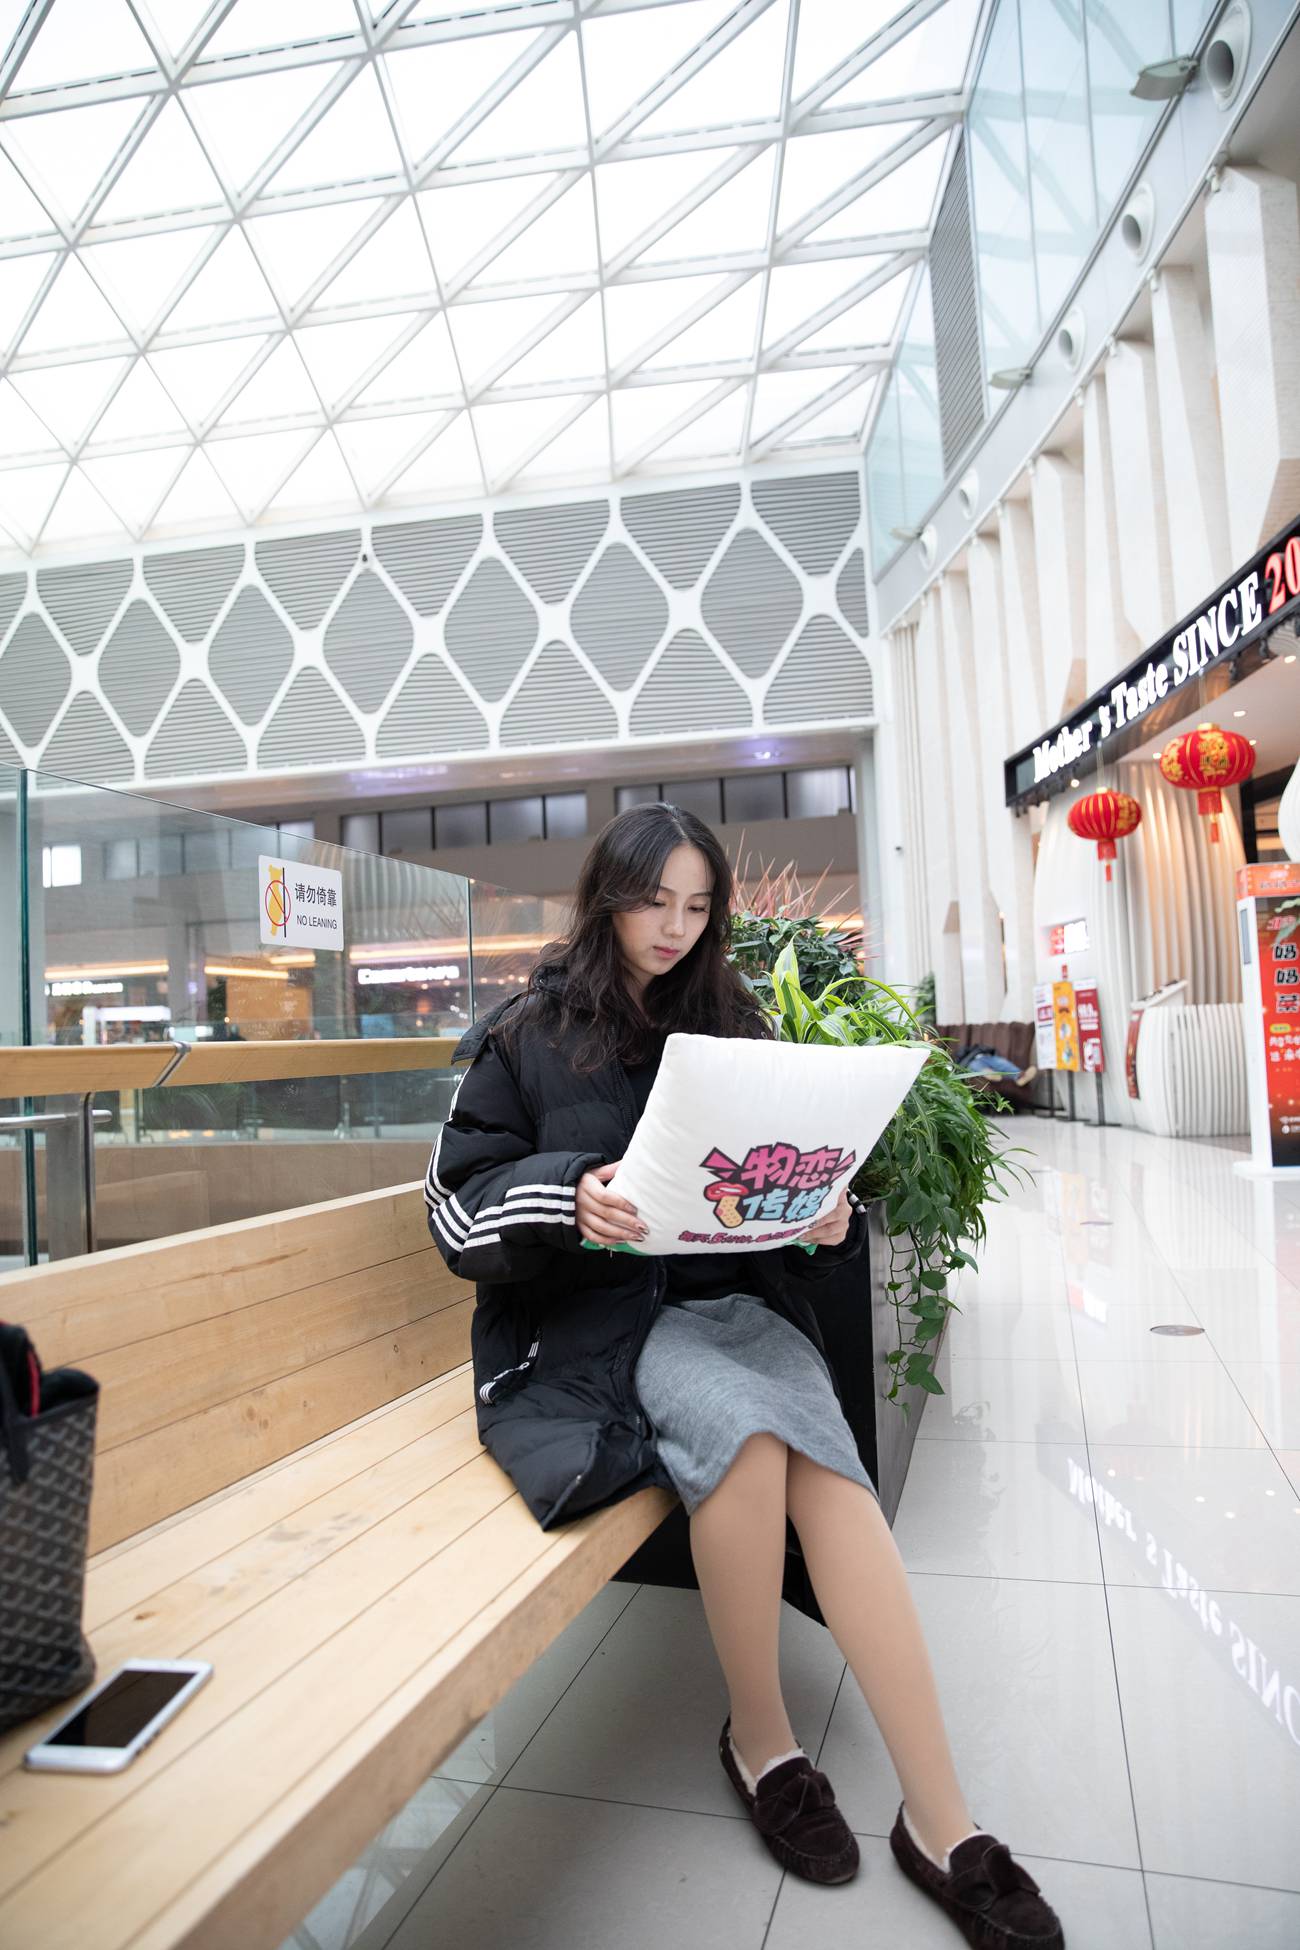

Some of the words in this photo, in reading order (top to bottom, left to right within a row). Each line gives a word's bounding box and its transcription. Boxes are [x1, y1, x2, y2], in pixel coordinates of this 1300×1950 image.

[1111, 662, 1169, 729] Taste
[1172, 571, 1262, 686] SINCE
[294, 882, 337, 907] 请勿倚靠
[296, 914, 308, 926] NO
[308, 917, 338, 930] LEANING
[740, 1143, 842, 1190] 物恋
